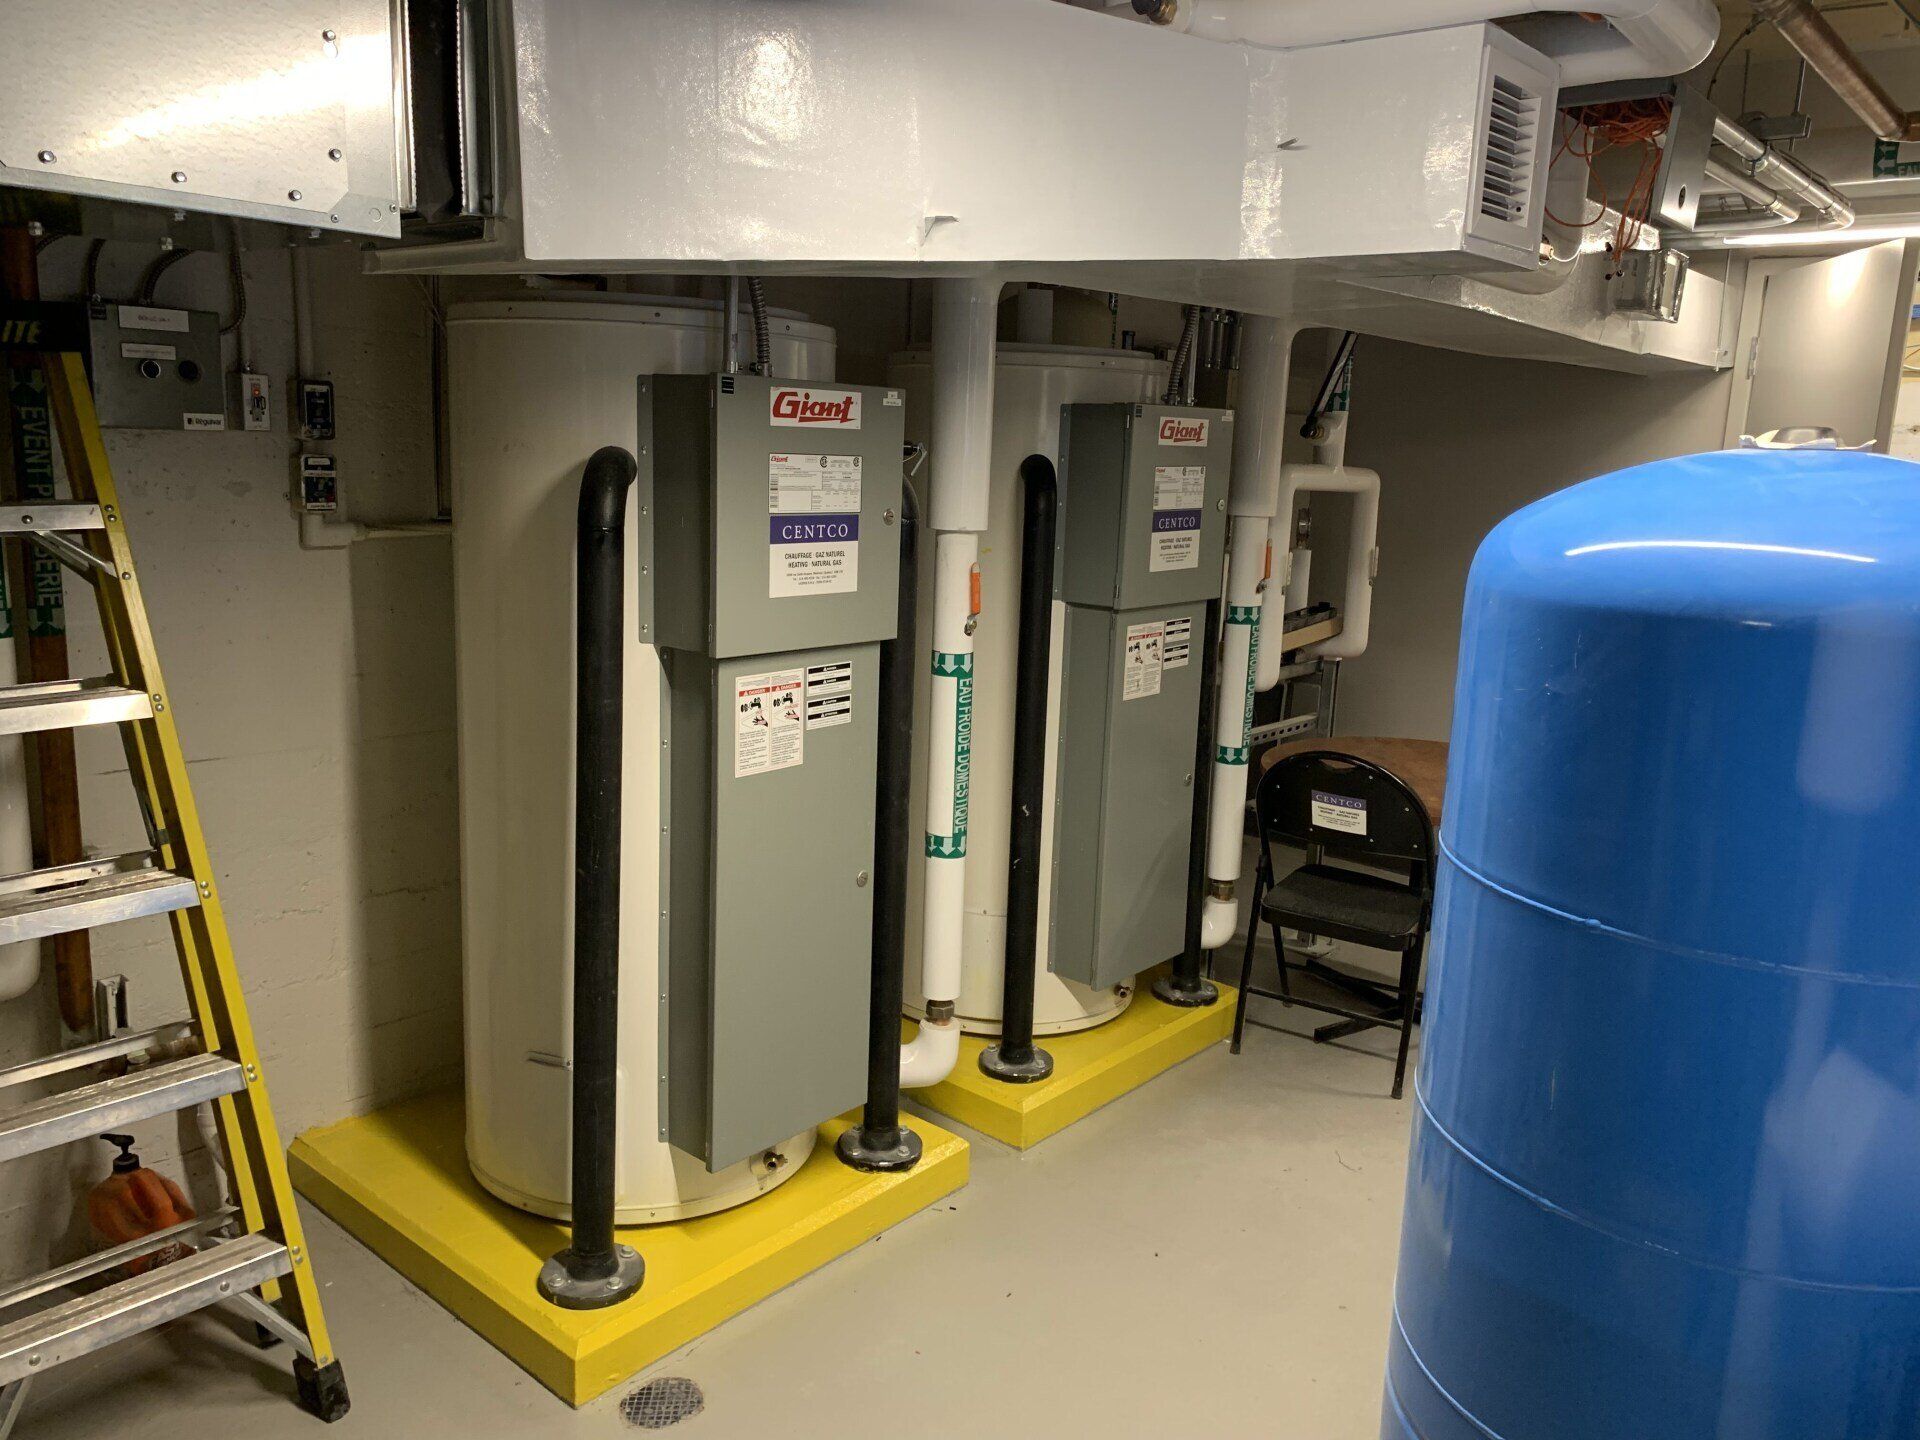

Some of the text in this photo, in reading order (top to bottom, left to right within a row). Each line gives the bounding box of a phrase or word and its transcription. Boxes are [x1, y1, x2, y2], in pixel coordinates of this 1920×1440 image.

[772, 391, 855, 423] Giant
[1160, 419, 1205, 443] Giant
[782, 523, 849, 540] CENTCO
[1158, 516, 1196, 529] CENTCO
[784, 552, 812, 560] CHAUFFAGE
[825, 550, 846, 558] NATUREL
[958, 677, 973, 703] EAU
[956, 707, 972, 753] FROIDE
[1316, 794, 1362, 808] CENTCO
